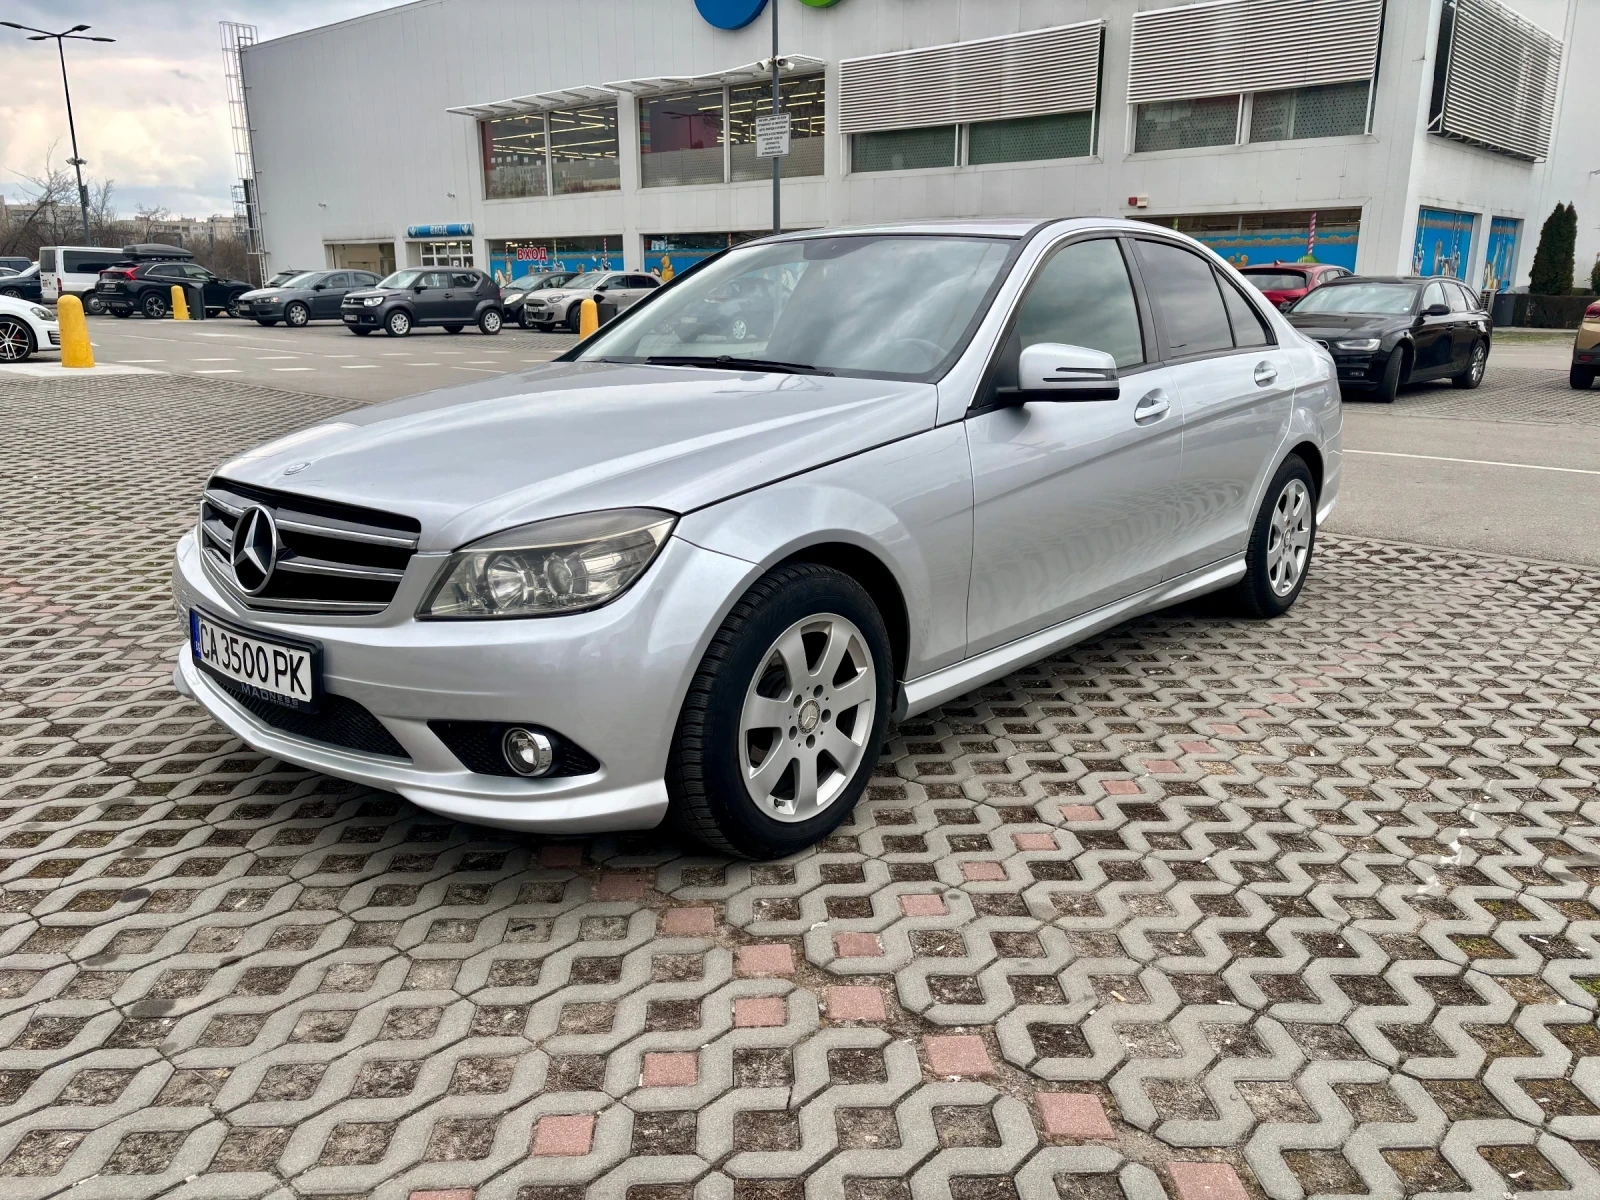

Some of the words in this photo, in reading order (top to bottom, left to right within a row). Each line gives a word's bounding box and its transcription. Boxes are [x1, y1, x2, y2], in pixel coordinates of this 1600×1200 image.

[430, 225, 448, 236] ВХОД
[517, 247, 548, 264] ВХОД
[200, 623, 220, 665] CA
[221, 632, 269, 683] 3500
[273, 649, 307, 696] PK
[241, 682, 299, 706] MADNESS
